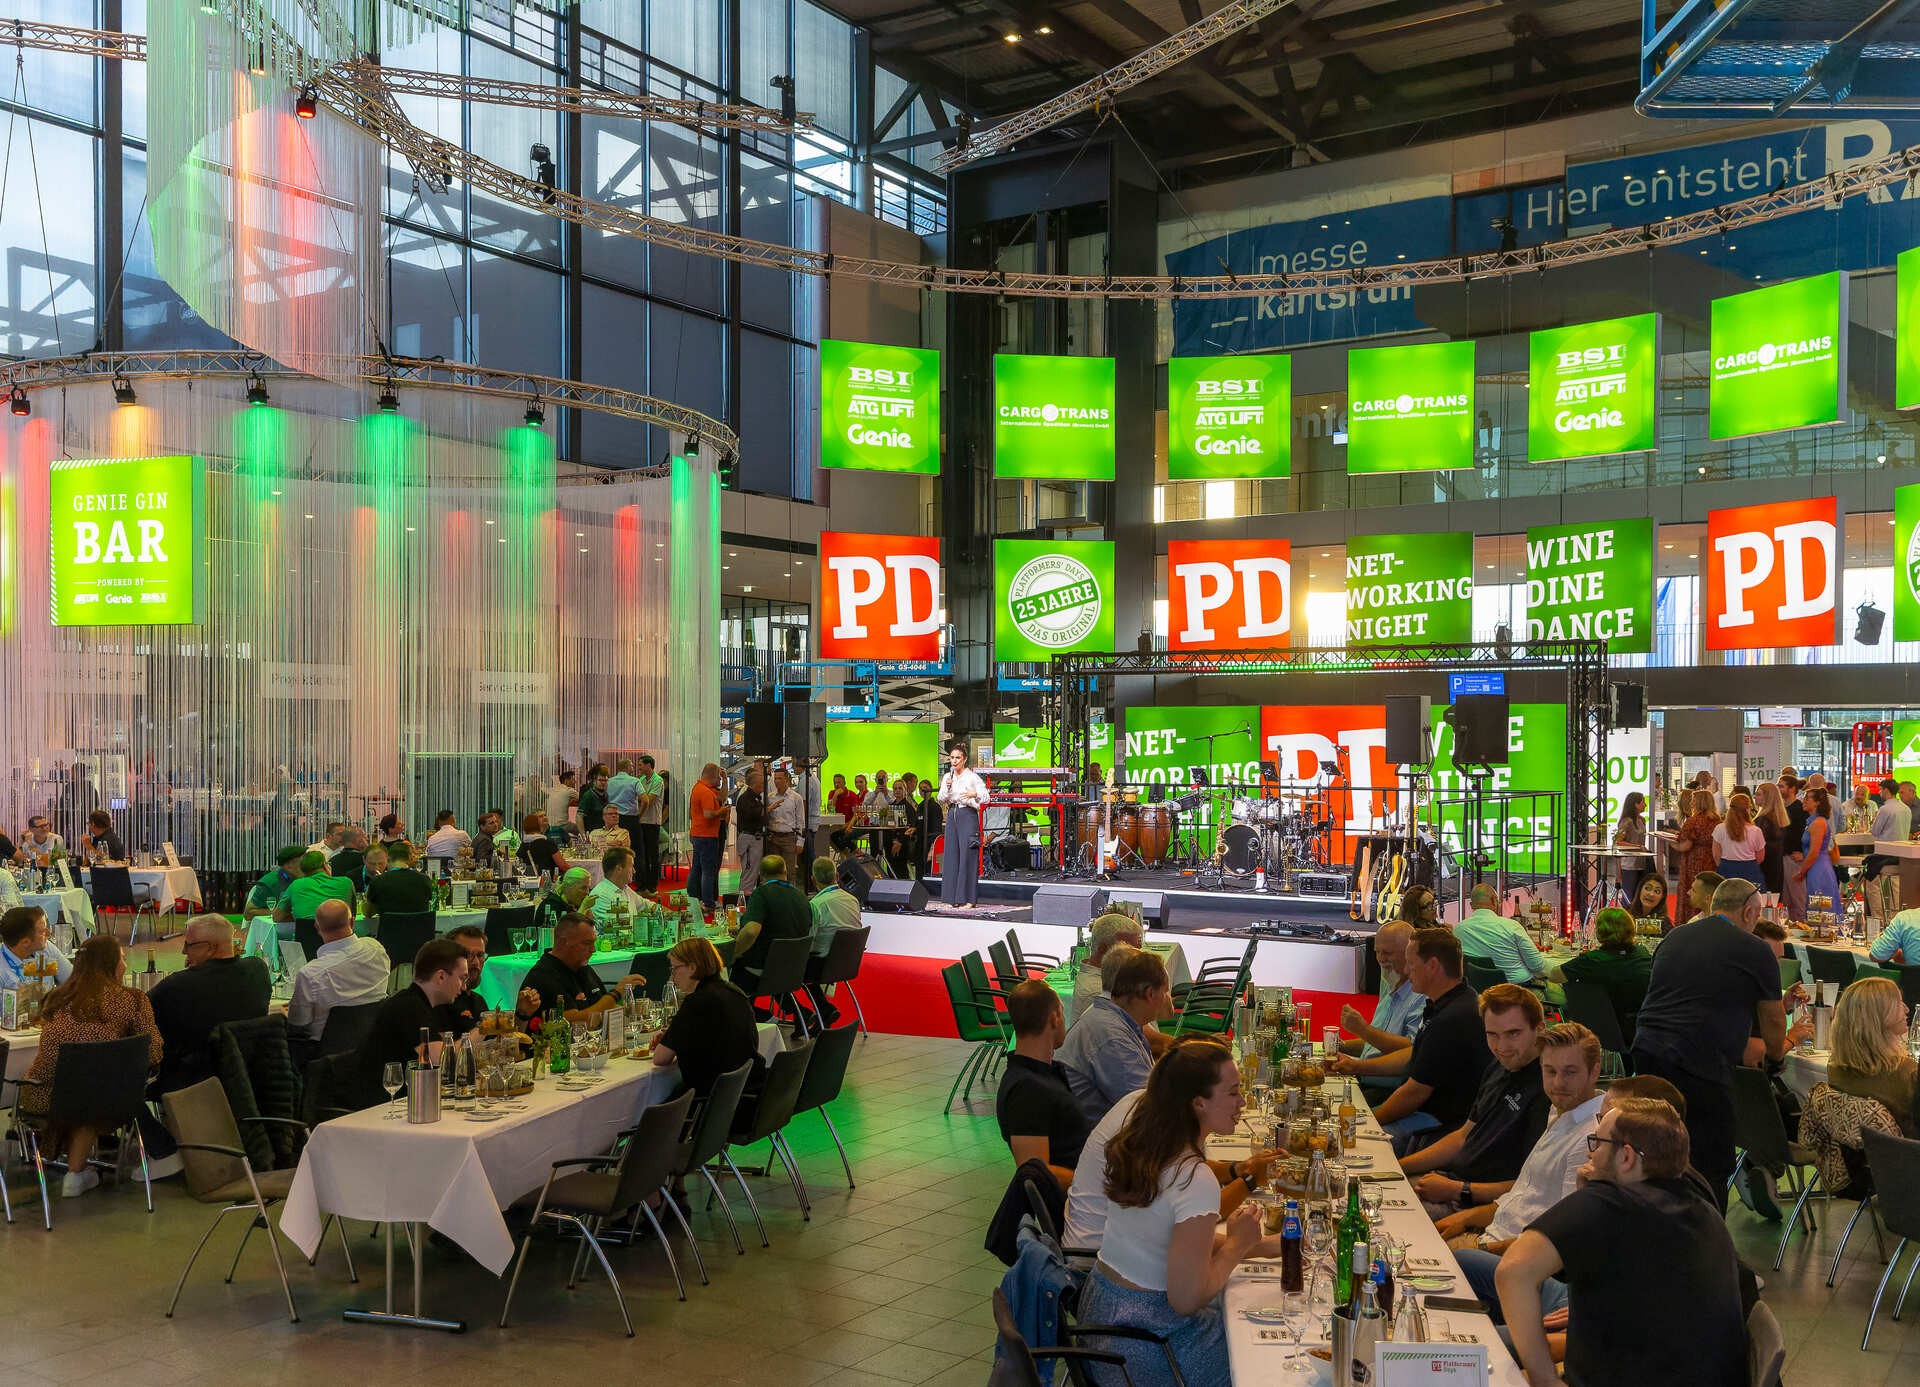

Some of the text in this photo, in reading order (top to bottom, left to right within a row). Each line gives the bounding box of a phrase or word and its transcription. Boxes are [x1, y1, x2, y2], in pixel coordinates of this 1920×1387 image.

[1527, 119, 1920, 229] Hier entsteht R
[1259, 240, 1367, 274] messe
[1556, 344, 1622, 368] BSI
[848, 366, 913, 386] BSI
[1195, 379, 1260, 395] BSI
[1555, 380, 1626, 402] ATG LIFT
[848, 399, 879, 415] ATG
[881, 402, 914, 418] LIFT
[1195, 411, 1264, 426] ATG LIFT
[1554, 407, 1626, 433] Genie
[847, 423, 915, 449] Genie
[1195, 434, 1264, 456] Genie
[73, 492, 168, 512] GENIE GIN
[73, 519, 168, 564] BAR
[1527, 529, 1615, 570] WINE
[1346, 552, 1405, 579] NET-
[1715, 520, 1836, 629] PD
[105, 593, 133, 604] Genie
[828, 555, 940, 639] PD
[1016, 582, 1095, 619] 25 JAHRE
[1176, 557, 1291, 643] PD
[1346, 577, 1473, 610] WORKING
[1527, 571, 1605, 608] DINE
[1027, 605, 1096, 642] DAS ORIGINAL
[1346, 613, 1428, 641] NIGHT
[1527, 607, 1634, 641] DANCE
[1453, 677, 1463, 690] P
[1125, 728, 1186, 757] NET-
[1743, 757, 1765, 769] SEE
[1750, 769, 1775, 780] YOU
